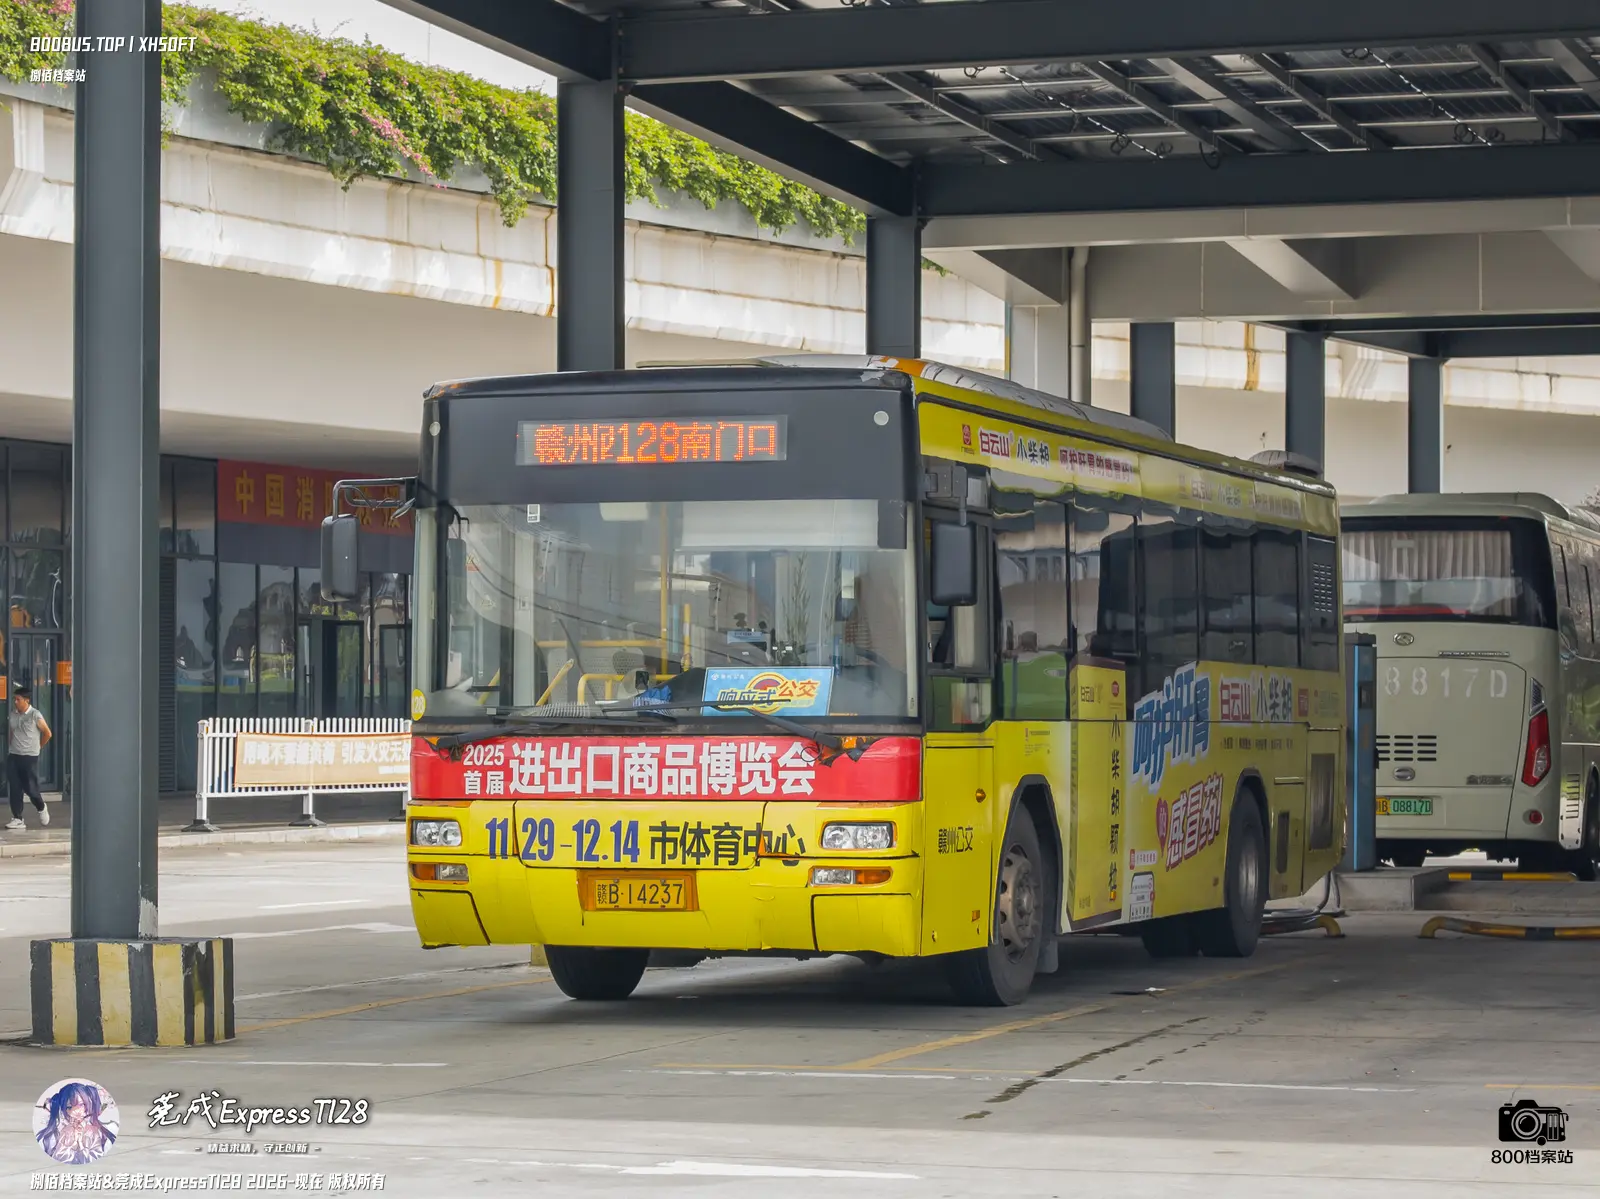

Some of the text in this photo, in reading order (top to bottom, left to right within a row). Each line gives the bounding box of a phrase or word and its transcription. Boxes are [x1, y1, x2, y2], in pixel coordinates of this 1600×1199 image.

[979, 430, 1010, 458] 白云山
[1017, 438, 1050, 466] 小柴胡
[778, 680, 819, 697] 公交
[1220, 677, 1251, 721] 白云山
[1256, 677, 1292, 721] 小柴胡
[1133, 667, 1211, 784] 呵护肝胃
[463, 744, 504, 766] 2025
[509, 741, 816, 796] 进出口商品博览会
[463, 771, 504, 795] 首届
[649, 820, 806, 866] 市体育中心
